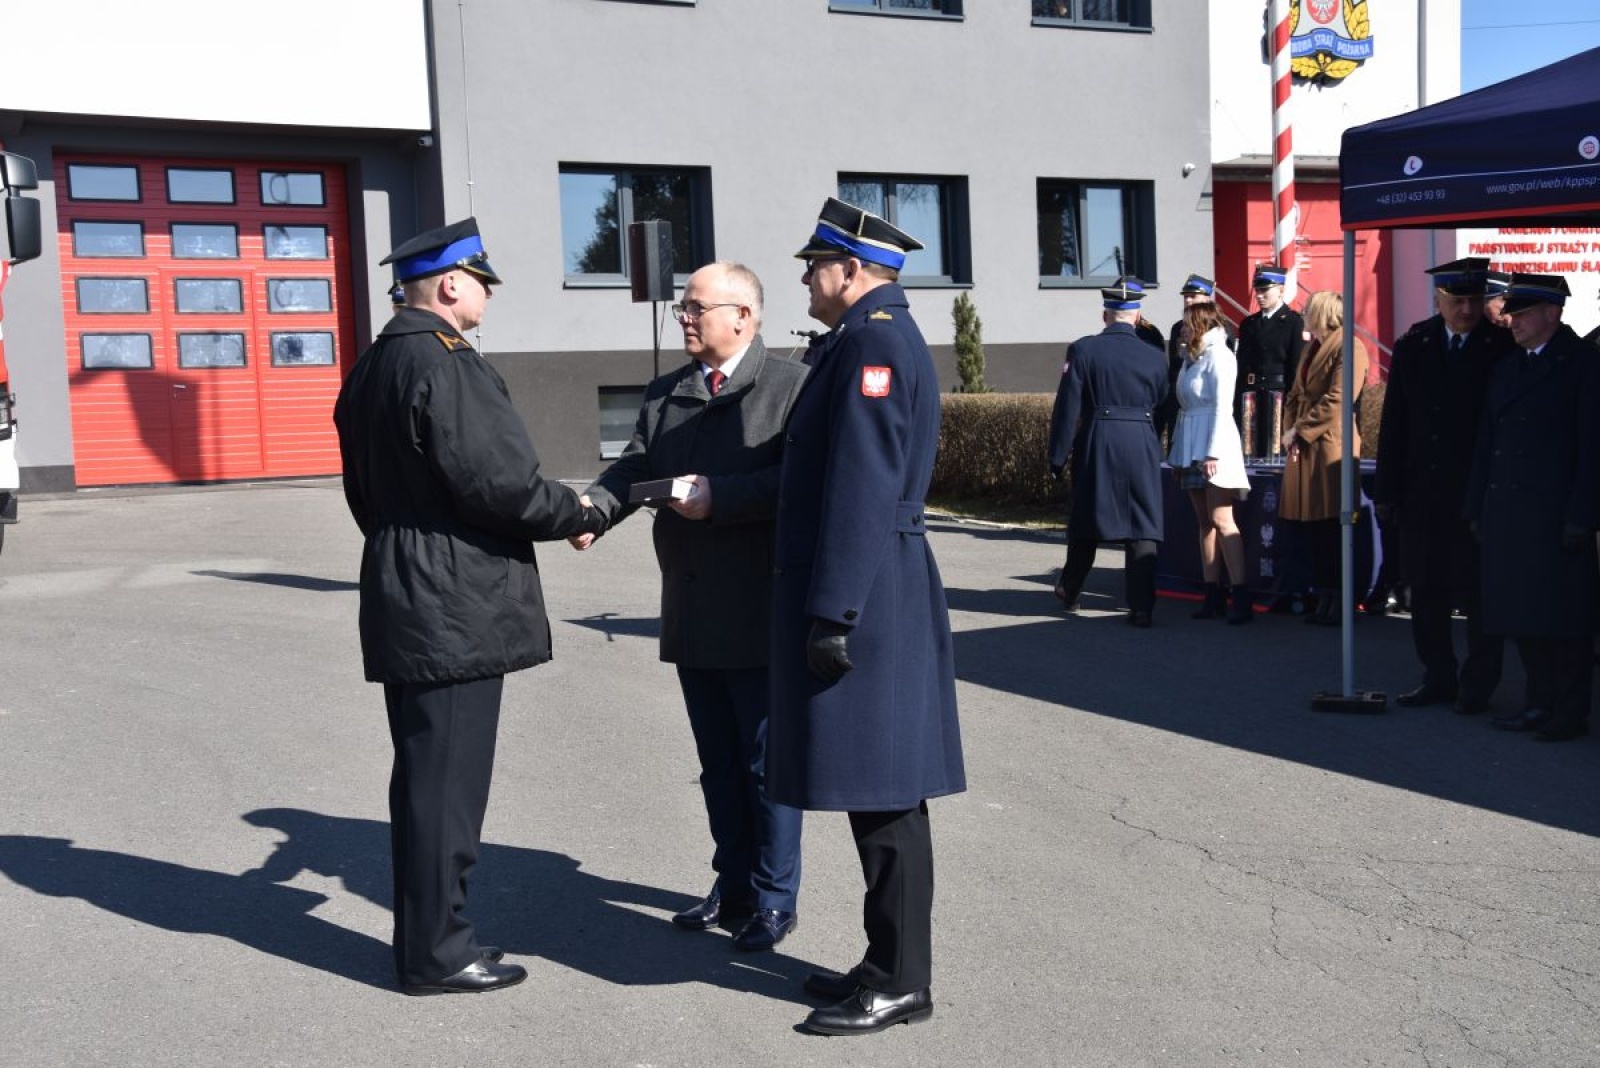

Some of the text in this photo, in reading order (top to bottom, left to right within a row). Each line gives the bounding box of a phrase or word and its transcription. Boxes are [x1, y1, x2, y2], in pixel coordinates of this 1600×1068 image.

[1336, 40, 1370, 56] POŻARNA
[1469, 240, 1544, 254] PAŃSTWOWEJ
[1547, 239, 1589, 253] STRAŻY
